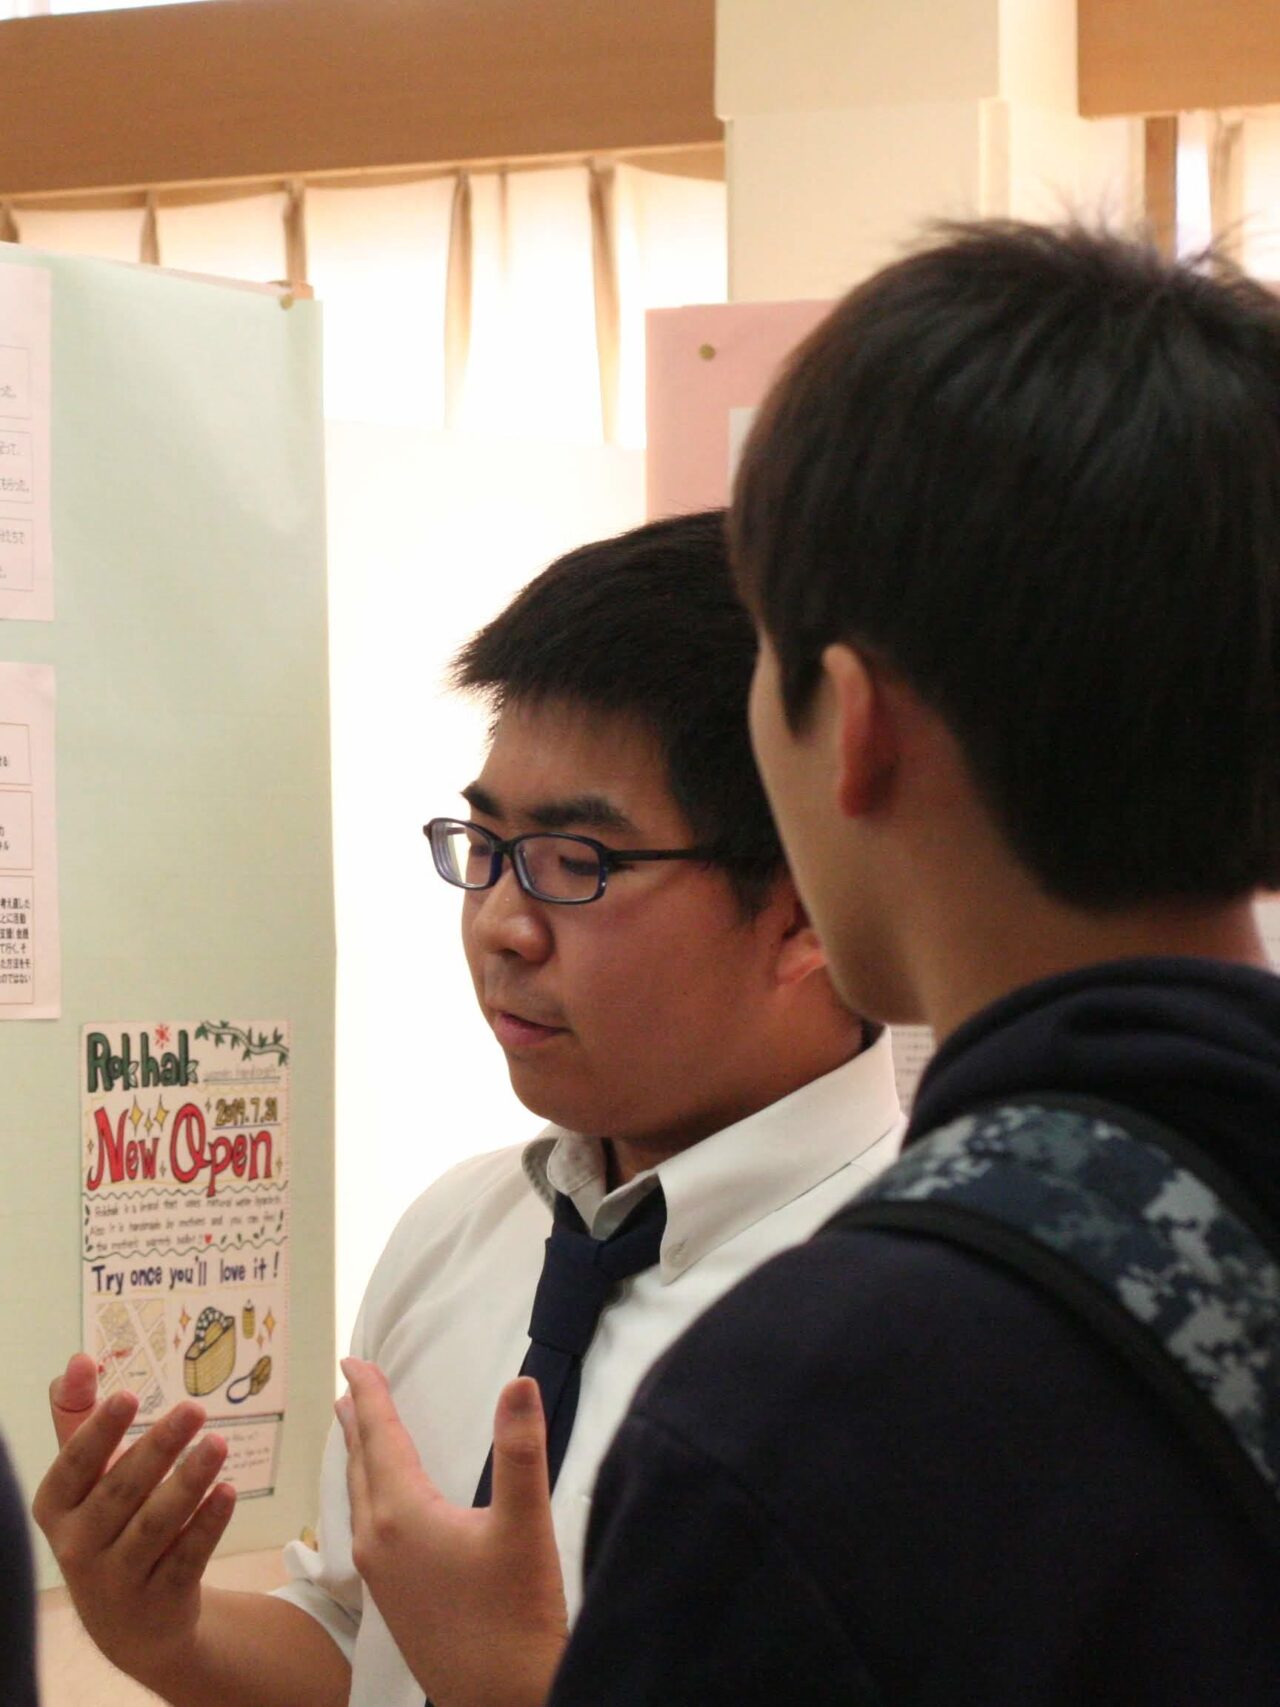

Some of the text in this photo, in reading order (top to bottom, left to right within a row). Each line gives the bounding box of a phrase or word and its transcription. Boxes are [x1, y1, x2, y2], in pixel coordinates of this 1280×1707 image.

[86, 1103, 272, 1198] New Open
[91, 1264, 124, 1295] Try
[130, 1265, 163, 1286] once
[169, 1256, 207, 1290] you'll
[220, 1258, 246, 1282] love
